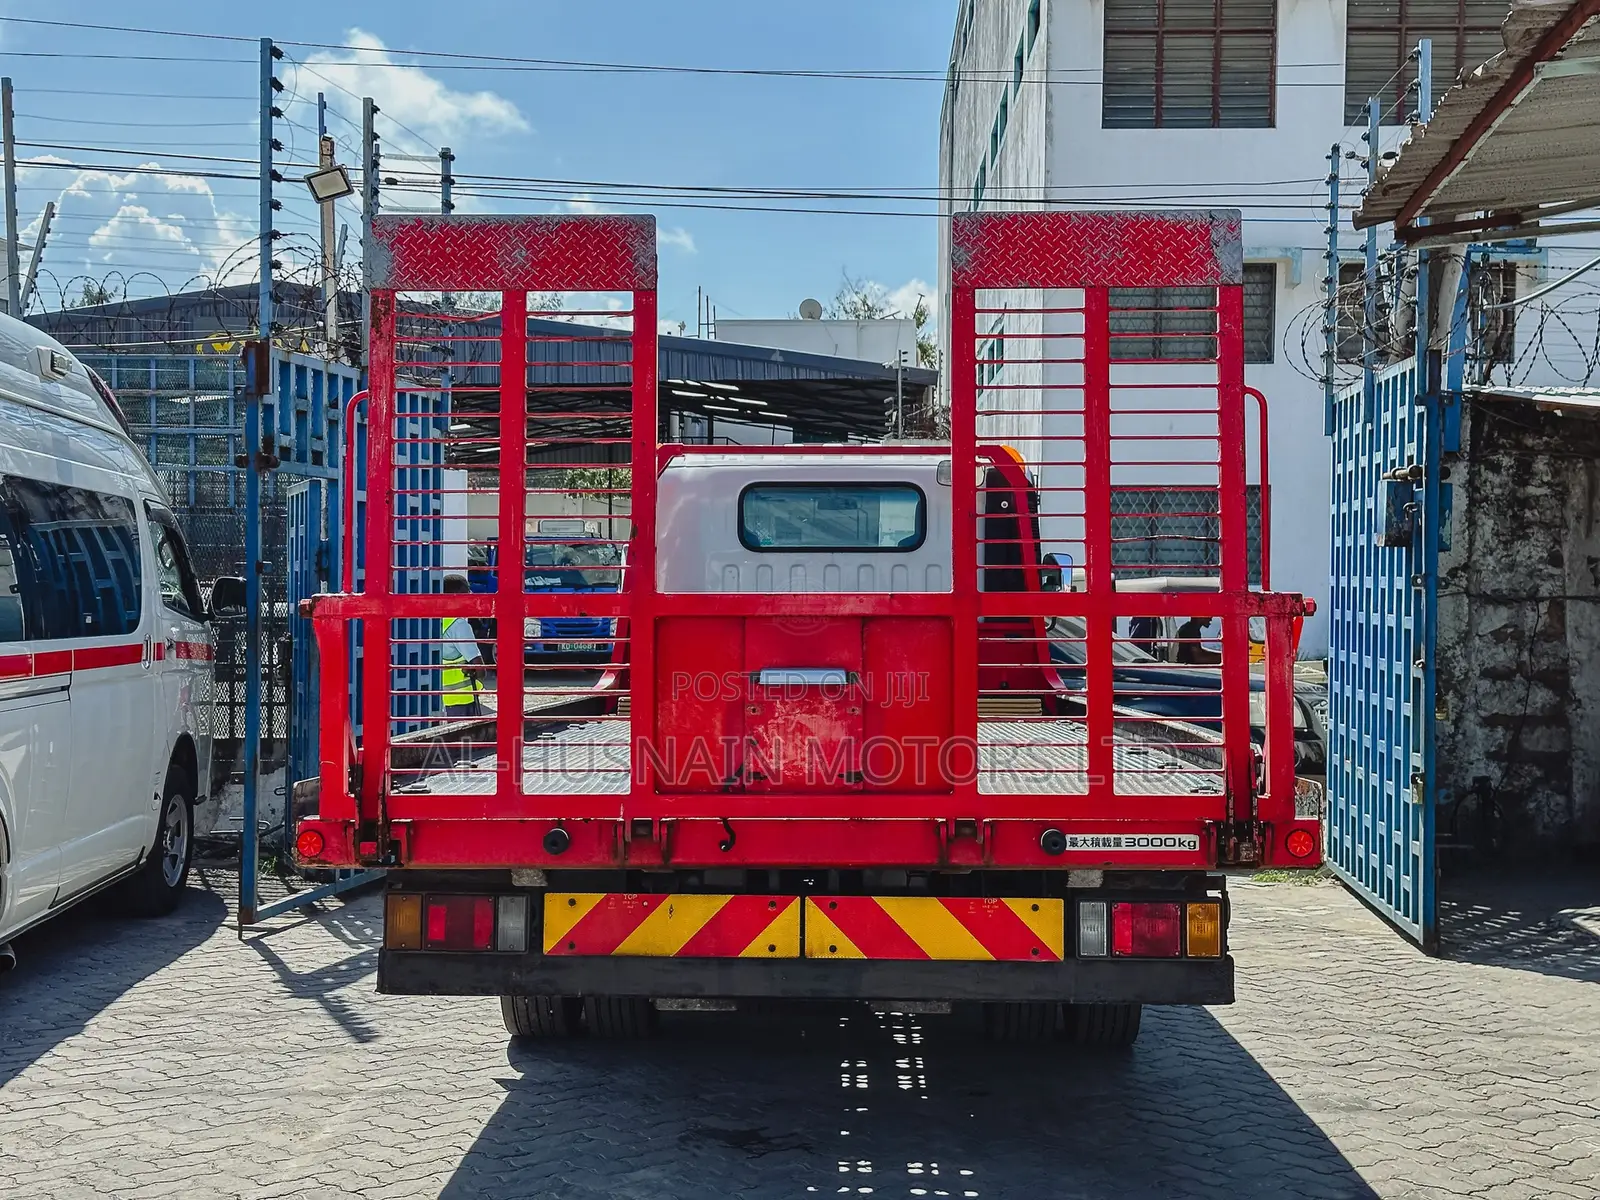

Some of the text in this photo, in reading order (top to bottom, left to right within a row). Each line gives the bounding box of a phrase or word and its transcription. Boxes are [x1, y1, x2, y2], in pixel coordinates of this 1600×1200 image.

[1068, 836, 1197, 850] 最大積載量 3000kg
